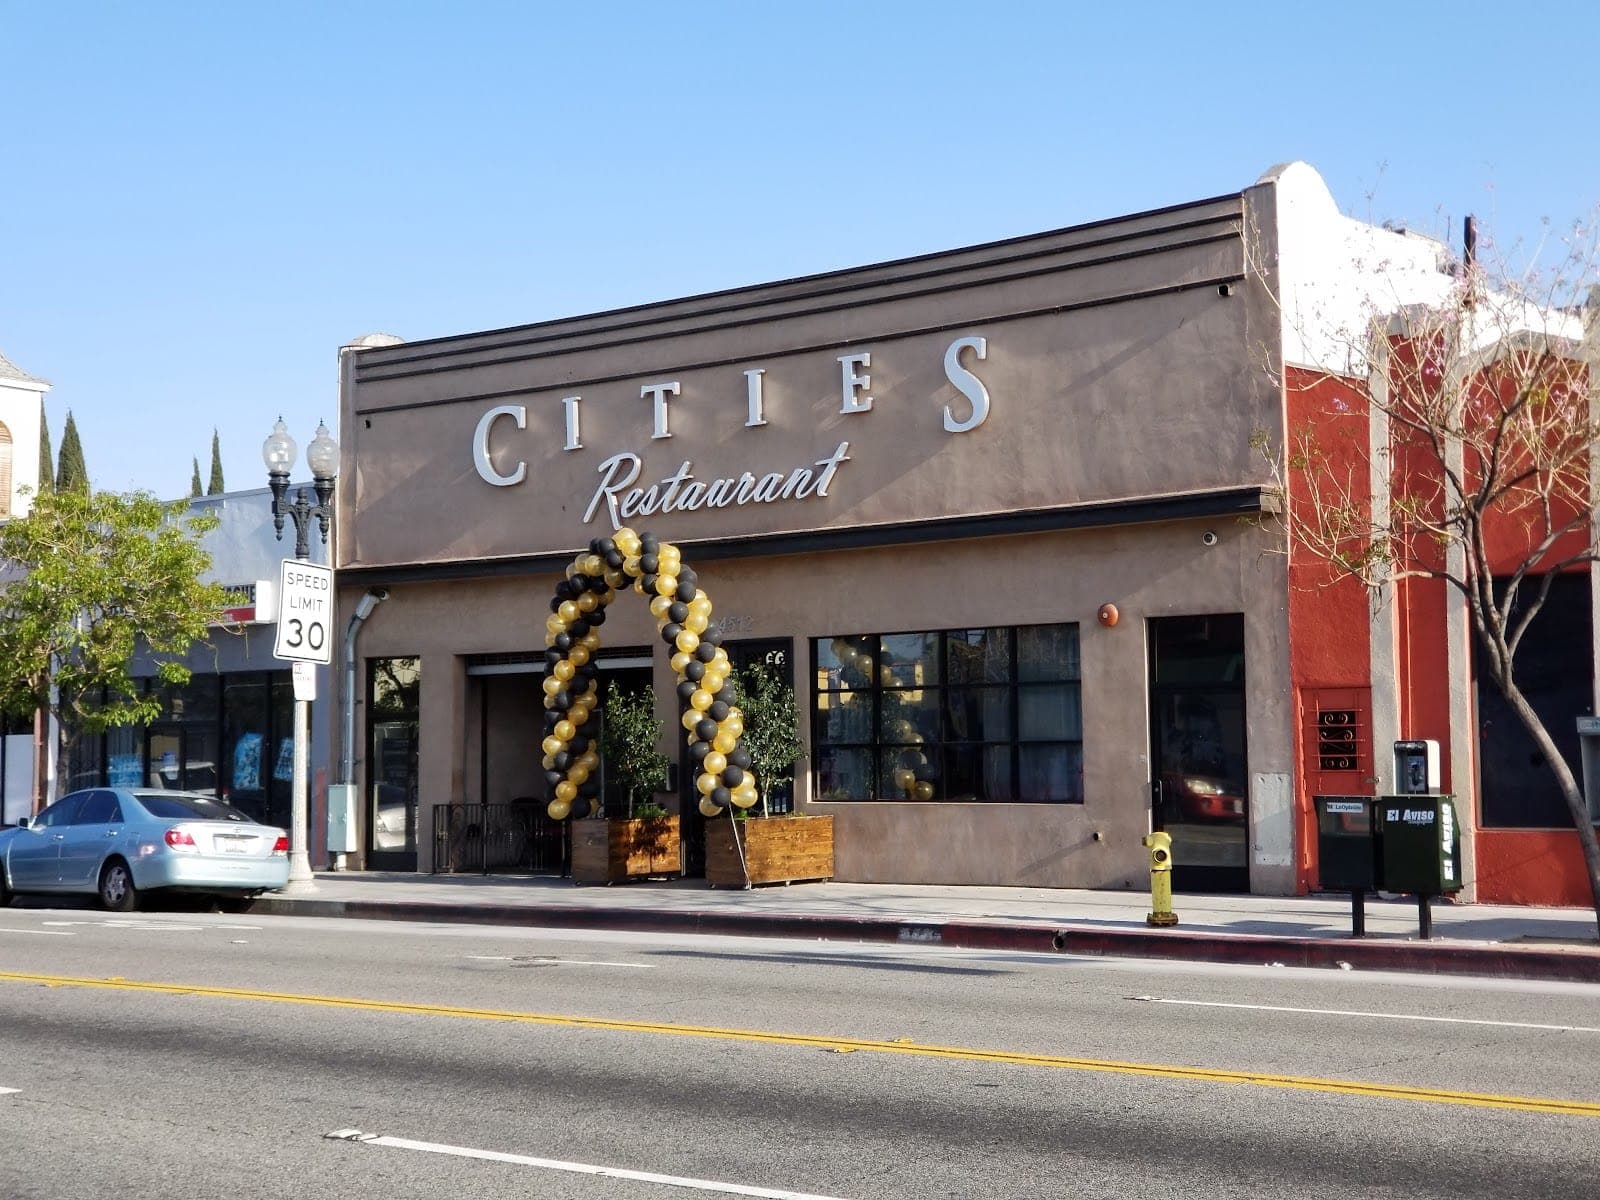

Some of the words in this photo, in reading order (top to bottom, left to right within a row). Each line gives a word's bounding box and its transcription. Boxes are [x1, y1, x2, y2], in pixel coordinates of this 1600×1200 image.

[472, 336, 990, 487] CITIES
[583, 441, 852, 527] Restaurant
[287, 572, 329, 591] SPEED
[290, 594, 323, 612] LIMIT
[286, 618, 324, 651] 30
[1386, 809, 1400, 821] El
